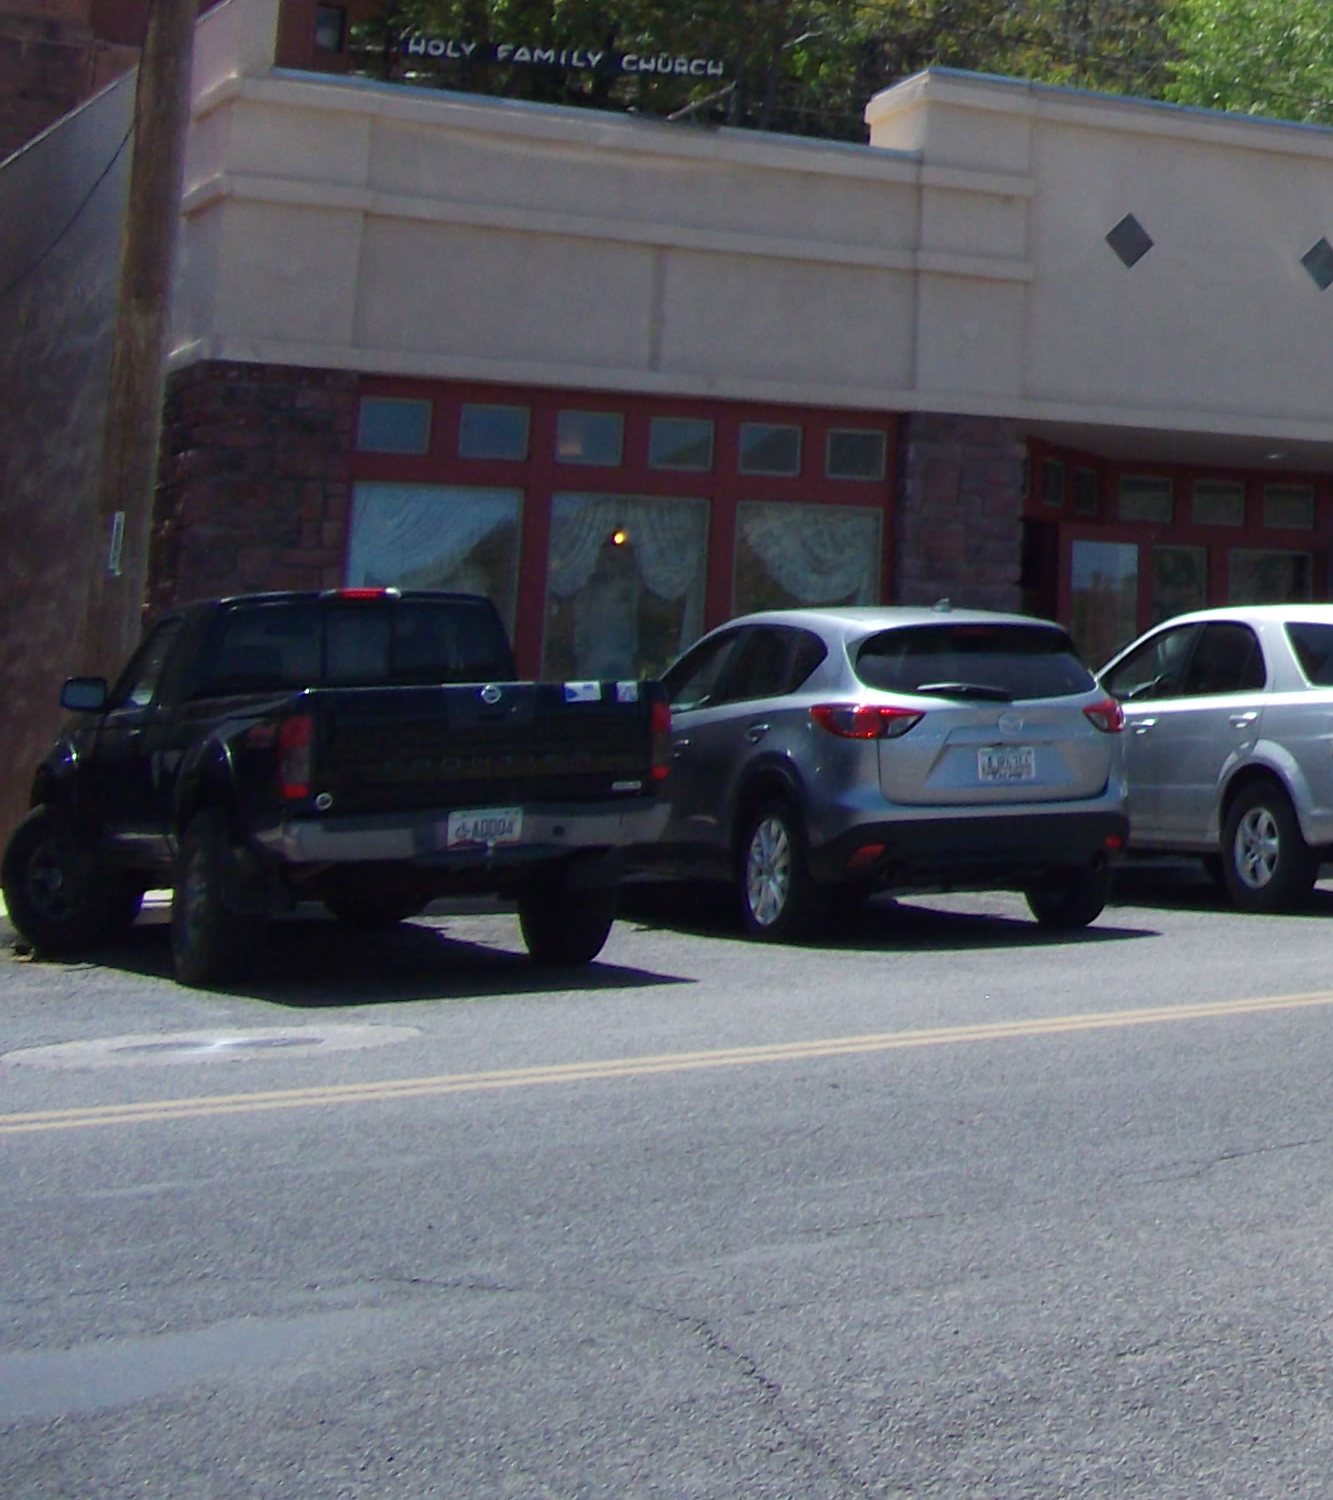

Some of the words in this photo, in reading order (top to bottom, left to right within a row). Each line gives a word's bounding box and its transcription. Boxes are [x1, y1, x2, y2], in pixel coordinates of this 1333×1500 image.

[407, 38, 476, 58] HOLY
[497, 43, 603, 68] FAMILY
[621, 53, 725, 77] CHURCH
